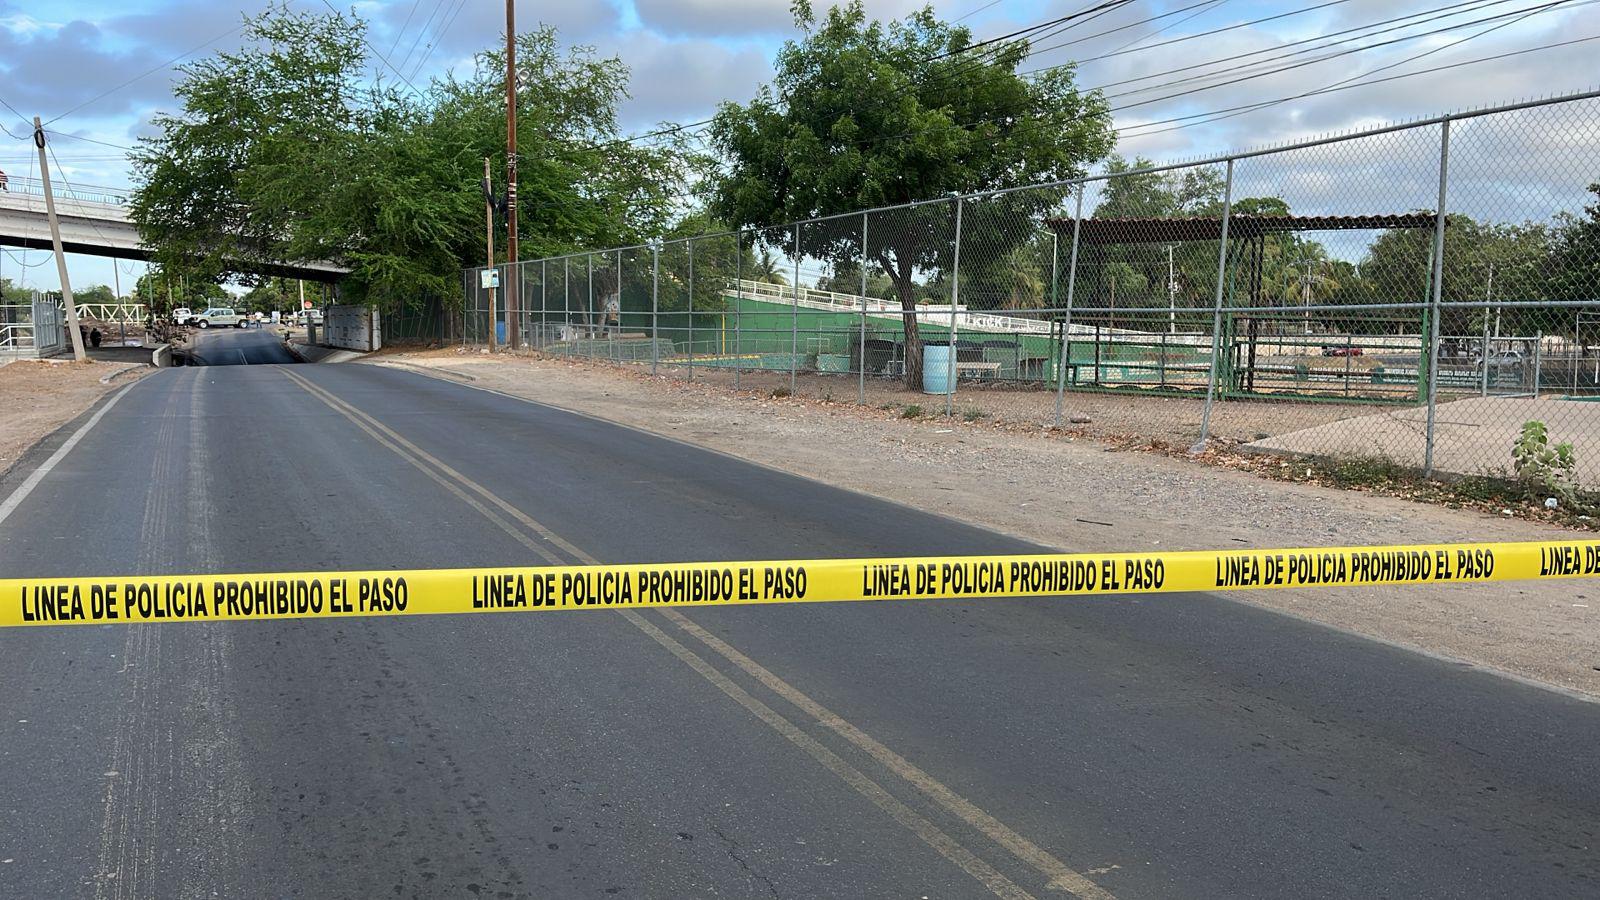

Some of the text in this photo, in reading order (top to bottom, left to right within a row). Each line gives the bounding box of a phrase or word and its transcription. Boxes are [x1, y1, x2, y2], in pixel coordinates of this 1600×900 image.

[862, 558, 1165, 597] LINEA DE POLICIA PROHIBIDO EL PASO
[1215, 549, 1494, 587] LINEA DE POLICIA PROHIBIDO EL PASO
[1540, 546, 1581, 576] LINEA
[21, 577, 408, 622] LINEA DE POLICIA PROHIBIDO EL PASO
[472, 566, 807, 609] LINEA DE POLICIA PROHIBIDO EL PASO
